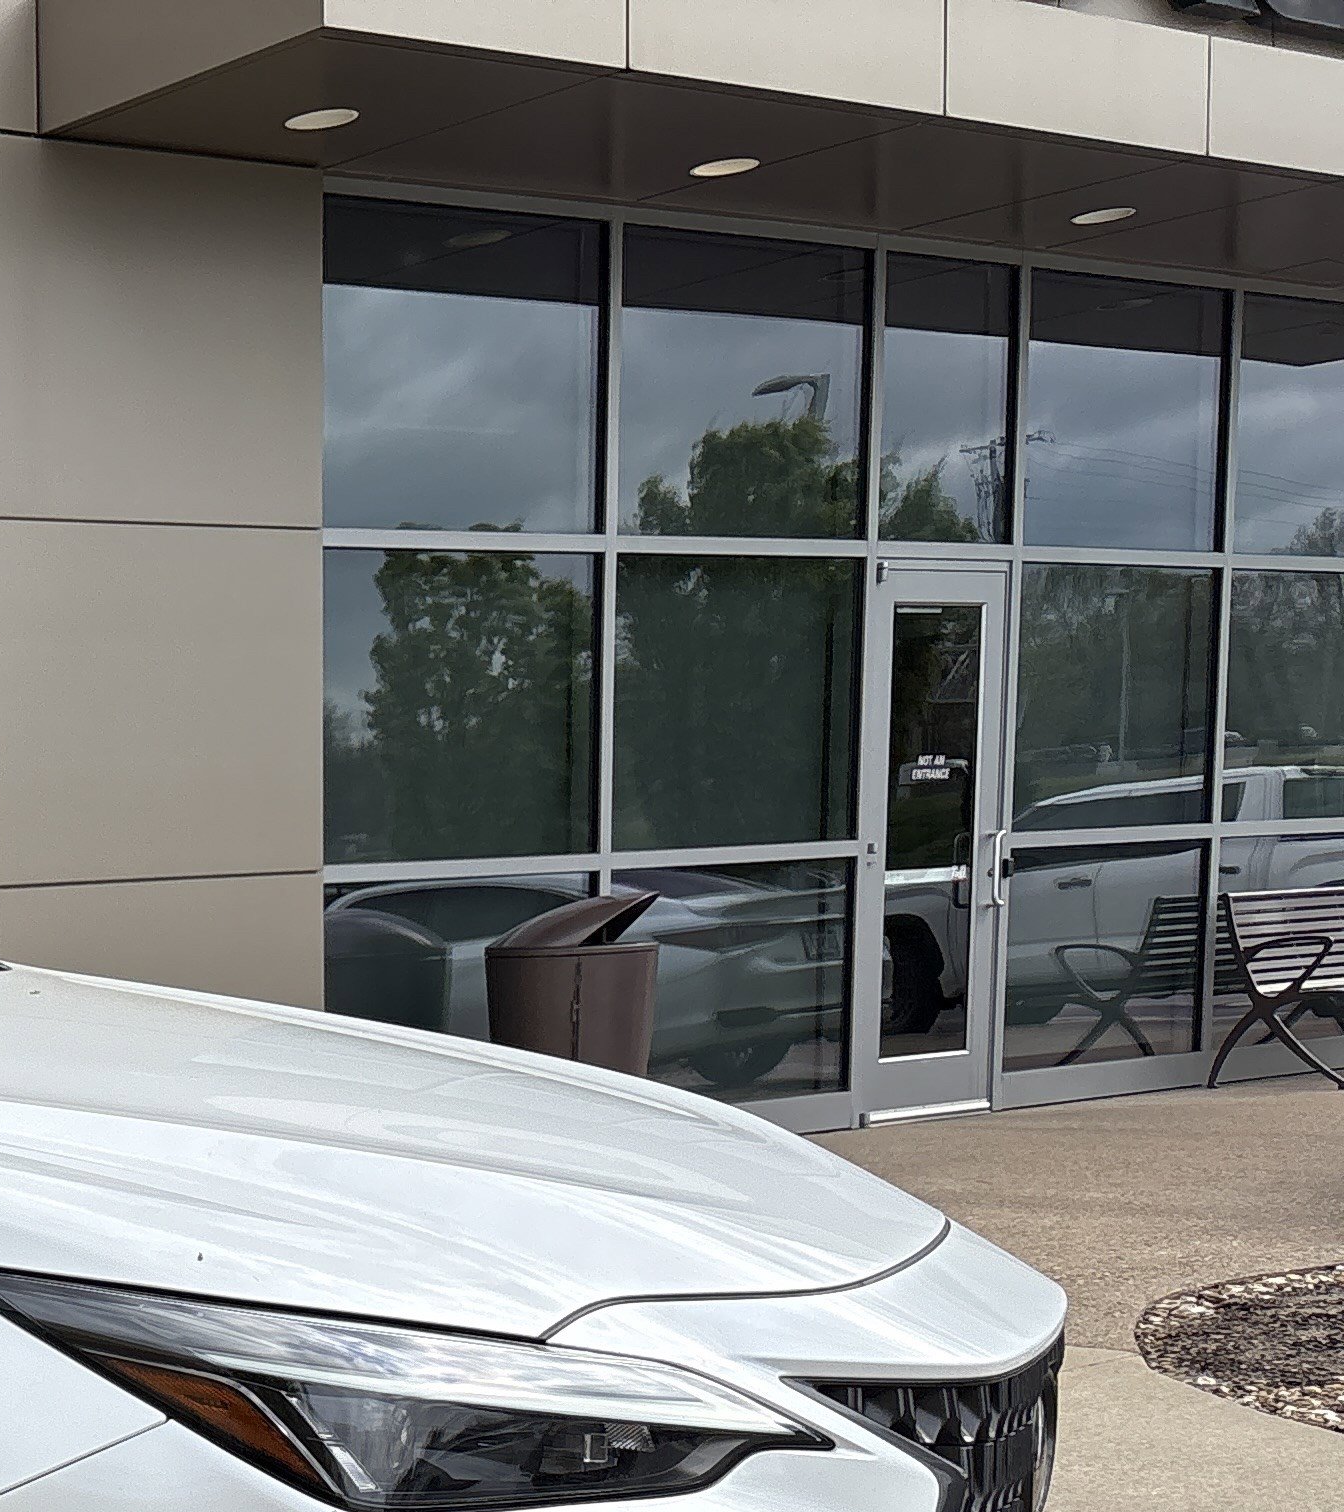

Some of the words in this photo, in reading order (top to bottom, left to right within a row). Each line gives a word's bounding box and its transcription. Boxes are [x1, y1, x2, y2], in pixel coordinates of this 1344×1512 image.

[917, 755, 933, 766] NOT
[934, 755, 946, 765] AN
[912, 768, 950, 779] ENTRANCE
